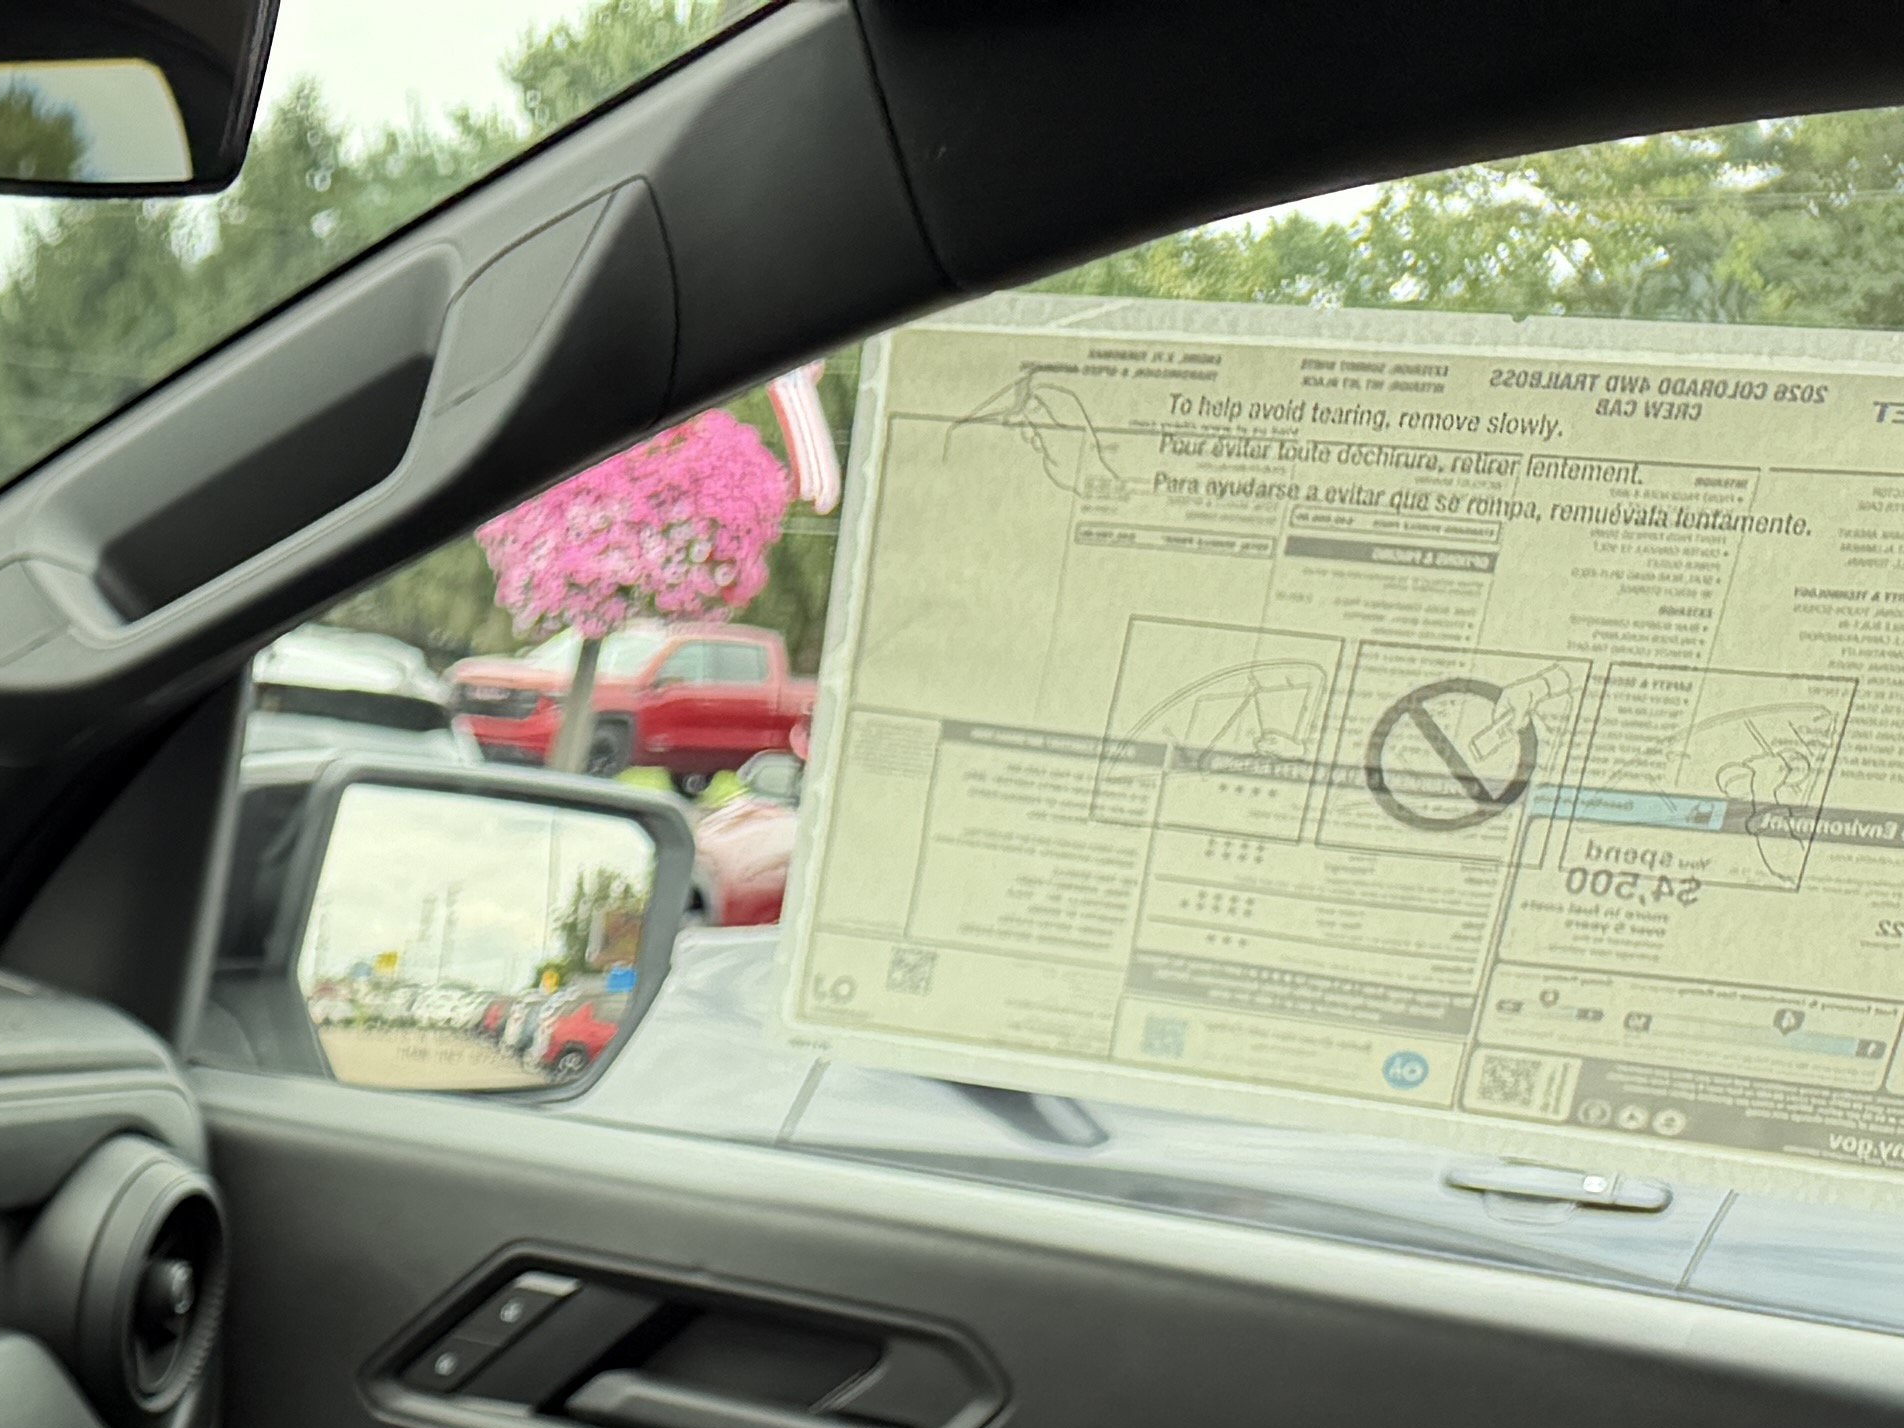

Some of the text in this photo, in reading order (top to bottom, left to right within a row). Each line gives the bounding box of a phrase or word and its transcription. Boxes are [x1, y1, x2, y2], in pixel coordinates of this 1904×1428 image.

[1168, 392, 1564, 441] To help avoid tearing, remove slowly.
[1159, 432, 1208, 457] Pour
[1278, 440, 1331, 464] toute
[1450, 452, 1521, 476] retirer
[1526, 454, 1644, 485] lentement.
[1153, 470, 1199, 495] Para
[1205, 477, 1300, 502] ayudarse
[1305, 485, 1319, 502] a
[1324, 484, 1385, 508] evitar
[1389, 491, 1429, 516] que
[1435, 494, 1461, 512] se
[1467, 497, 1542, 524] rompa,
[1674, 509, 1812, 538] lentamente.
